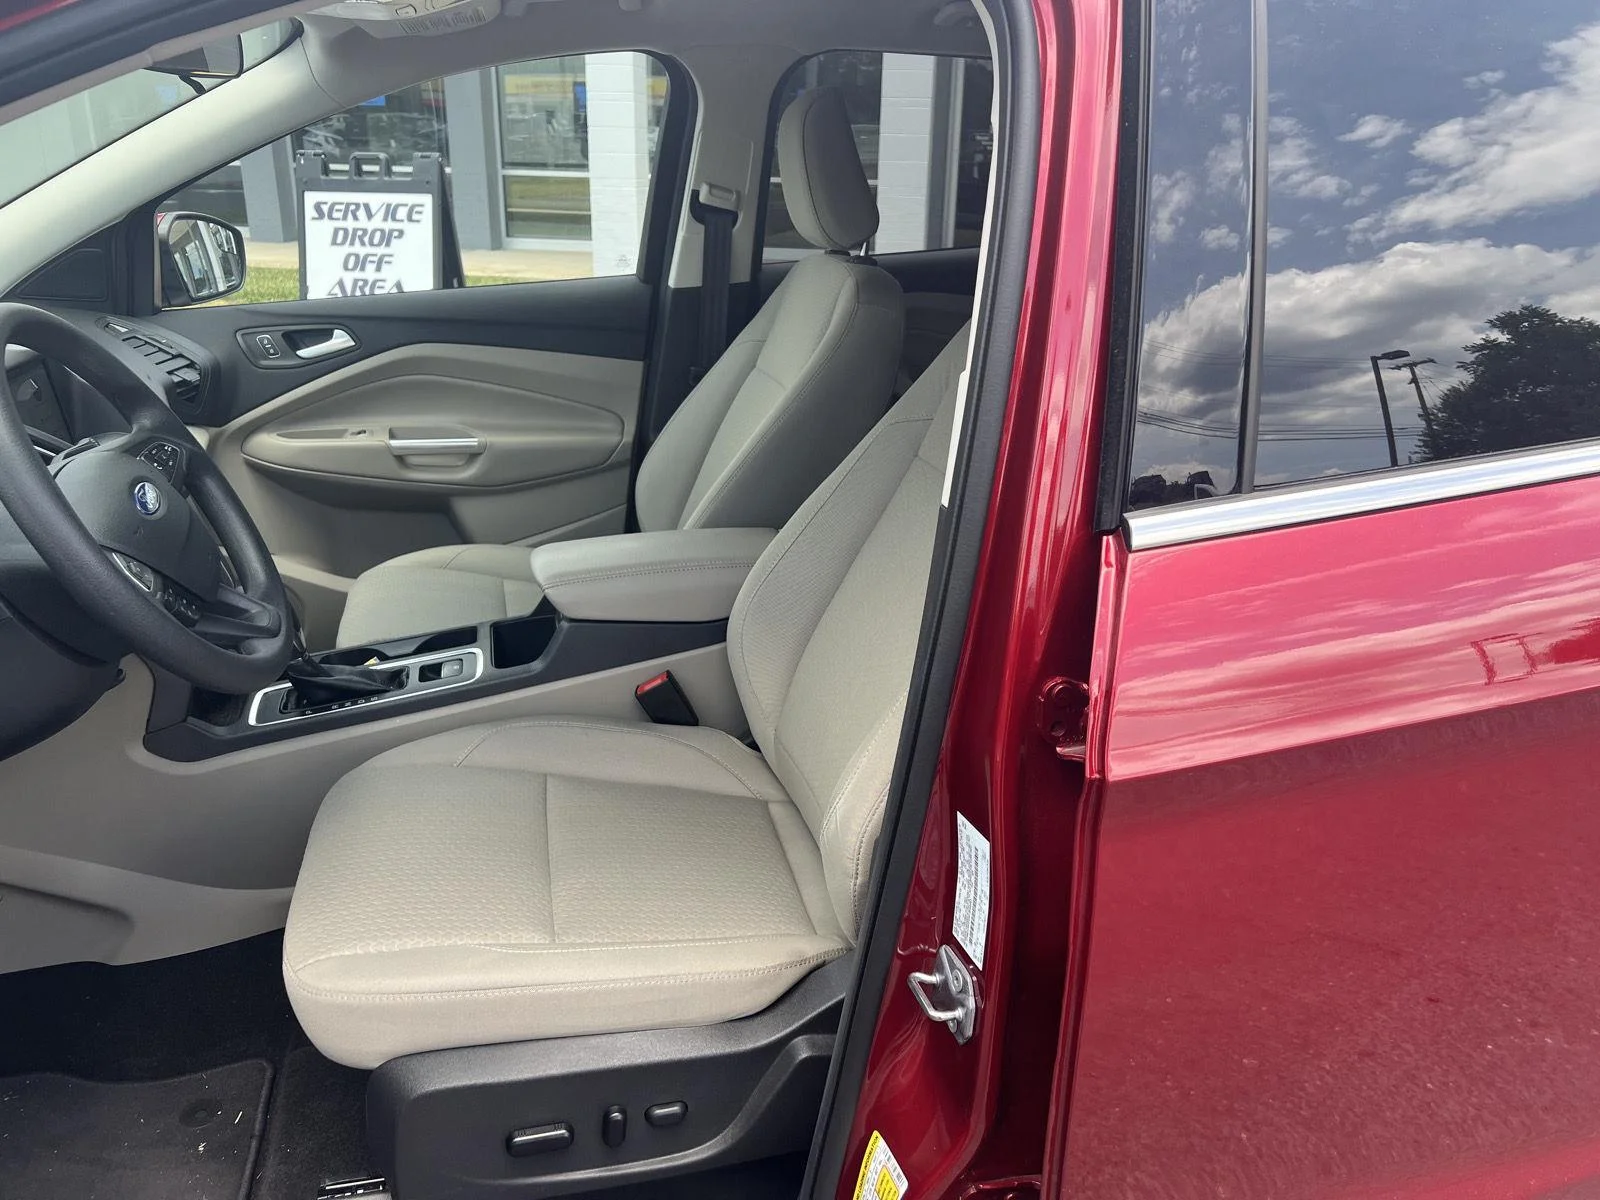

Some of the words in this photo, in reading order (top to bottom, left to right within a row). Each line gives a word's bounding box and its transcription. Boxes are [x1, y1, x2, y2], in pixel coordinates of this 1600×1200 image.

[311, 201, 425, 223] SERVICE
[330, 227, 405, 247] DROP
[342, 253, 394, 272] OFF
[327, 277, 404, 297] AREA
